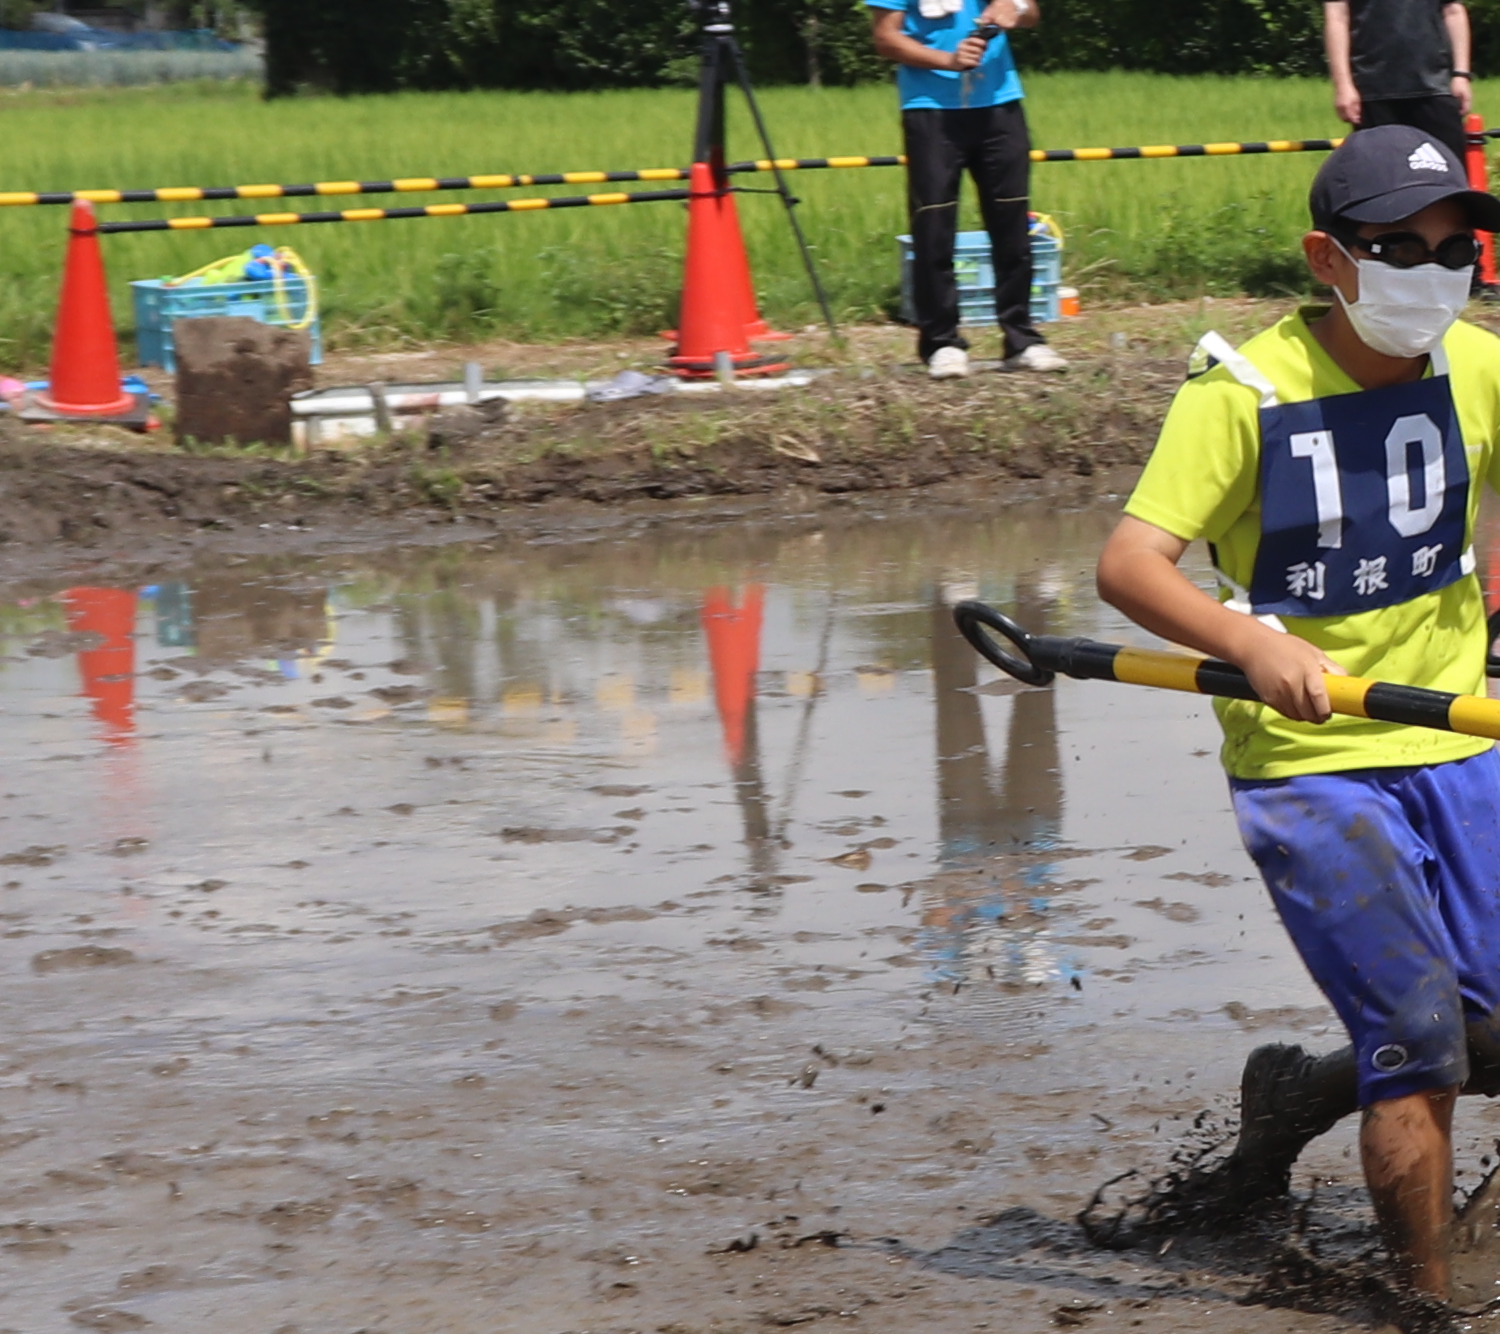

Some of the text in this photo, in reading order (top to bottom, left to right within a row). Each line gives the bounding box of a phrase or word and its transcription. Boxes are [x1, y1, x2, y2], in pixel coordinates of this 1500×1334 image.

[1289, 412, 1446, 549] 10
[1285, 542, 1444, 601] 利根町
